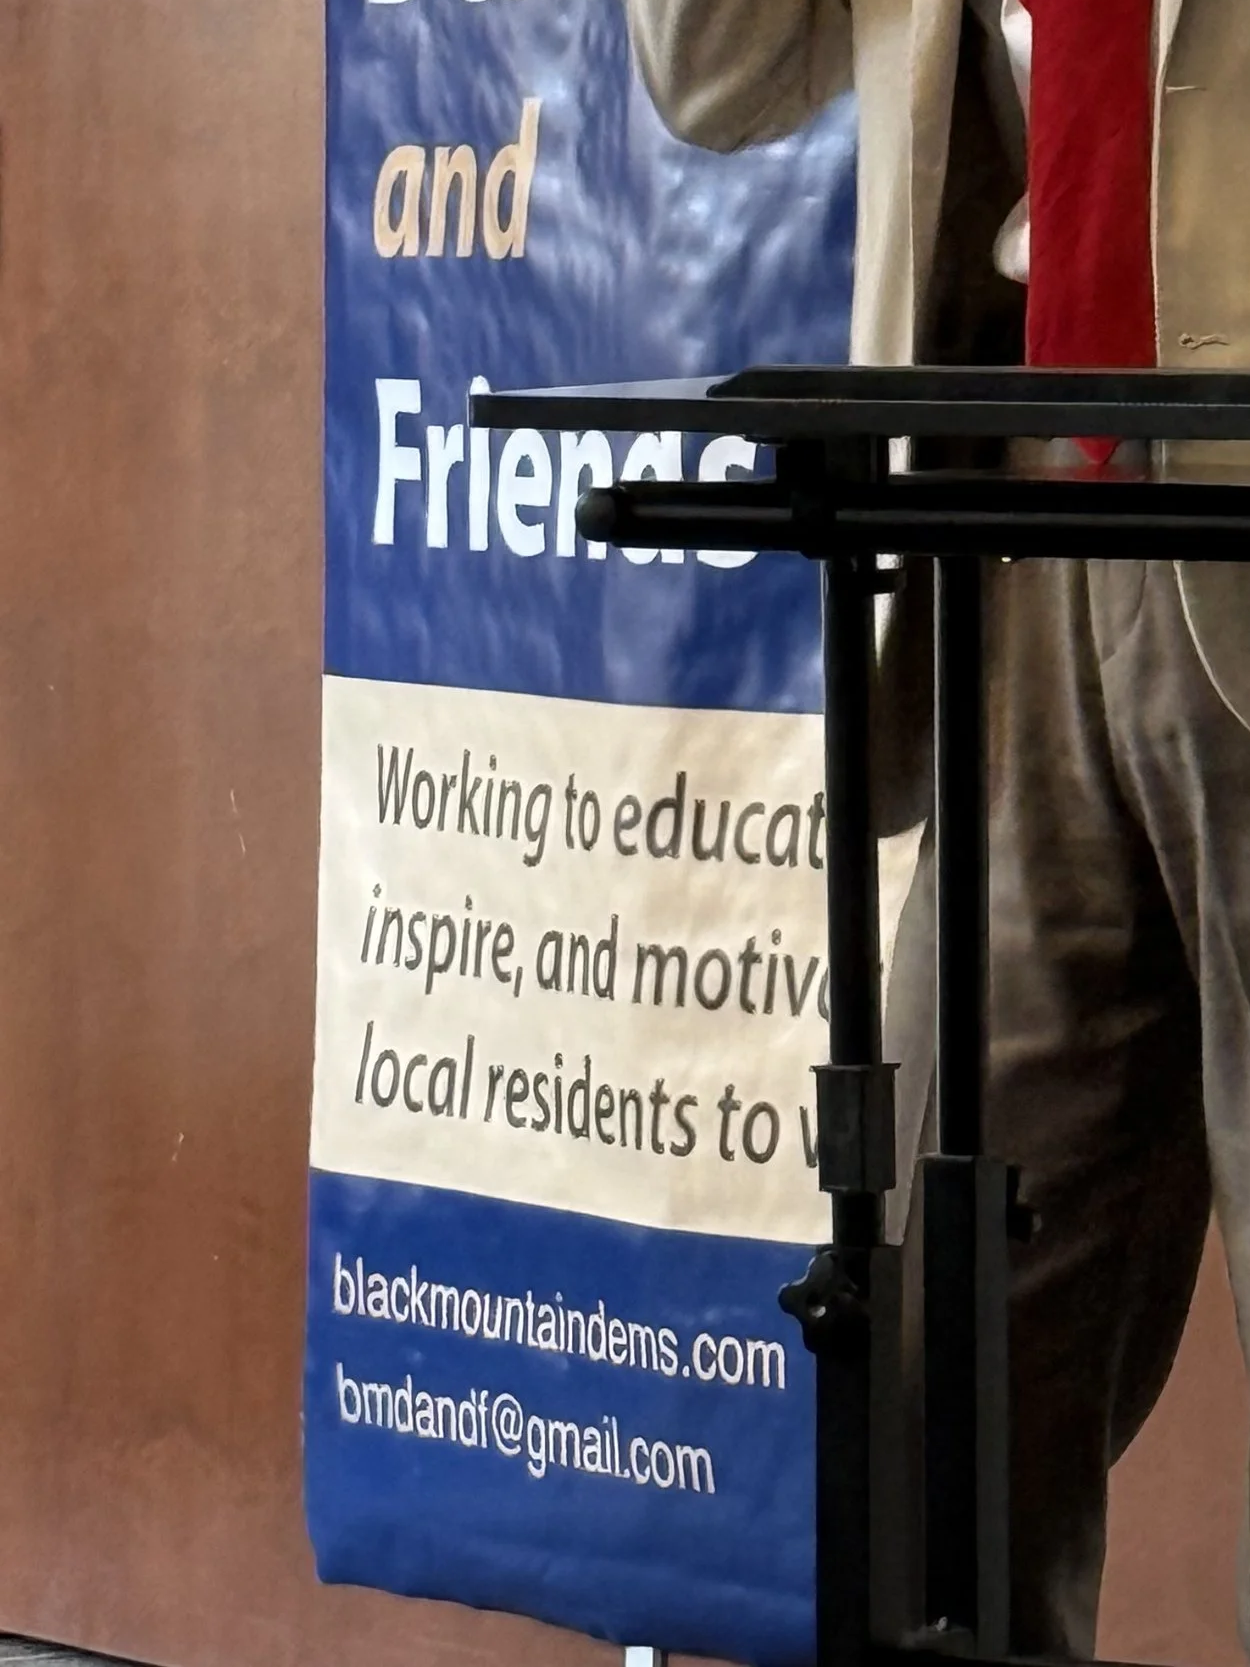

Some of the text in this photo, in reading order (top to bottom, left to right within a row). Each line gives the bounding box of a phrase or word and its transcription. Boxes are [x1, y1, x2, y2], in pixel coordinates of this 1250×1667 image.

[374, 97, 541, 259] and
[377, 743, 552, 867] Working
[565, 772, 600, 851] to
[360, 882, 524, 997] inspire,
[535, 913, 619, 1000] and
[354, 1020, 475, 1121] local
[483, 1052, 698, 1158] residents
[717, 1082, 780, 1164] to
[332, 1252, 786, 1390] blackmountaindems.com
[335, 1362, 716, 1495] bmdandf@gmail.com
